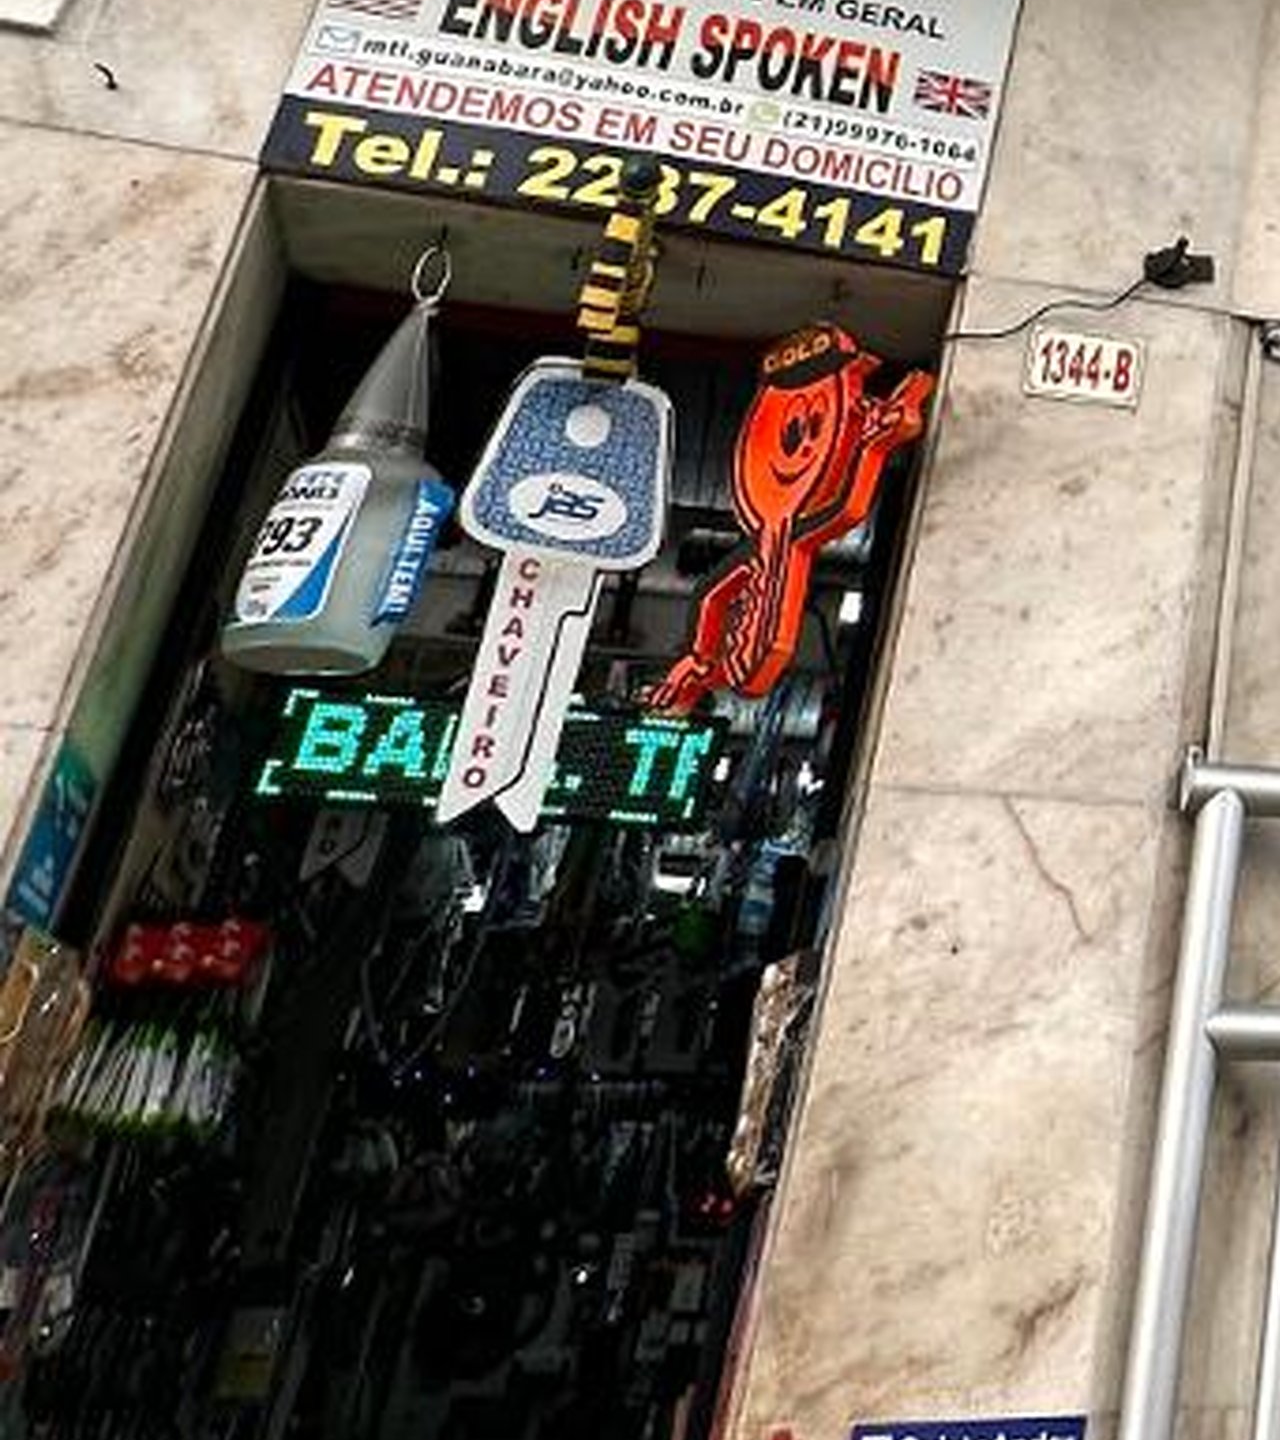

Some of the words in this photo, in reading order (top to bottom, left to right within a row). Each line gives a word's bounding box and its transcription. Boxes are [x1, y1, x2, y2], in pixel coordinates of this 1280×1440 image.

[306, 62, 583, 133] ATENDEMOS
[594, 109, 658, 147] EM
[668, 121, 753, 162] SEU
[691, 13, 902, 114] SPOKEN
[305, 111, 495, 188] Tel.:
[462, 557, 541, 789] CHAVEIRO
